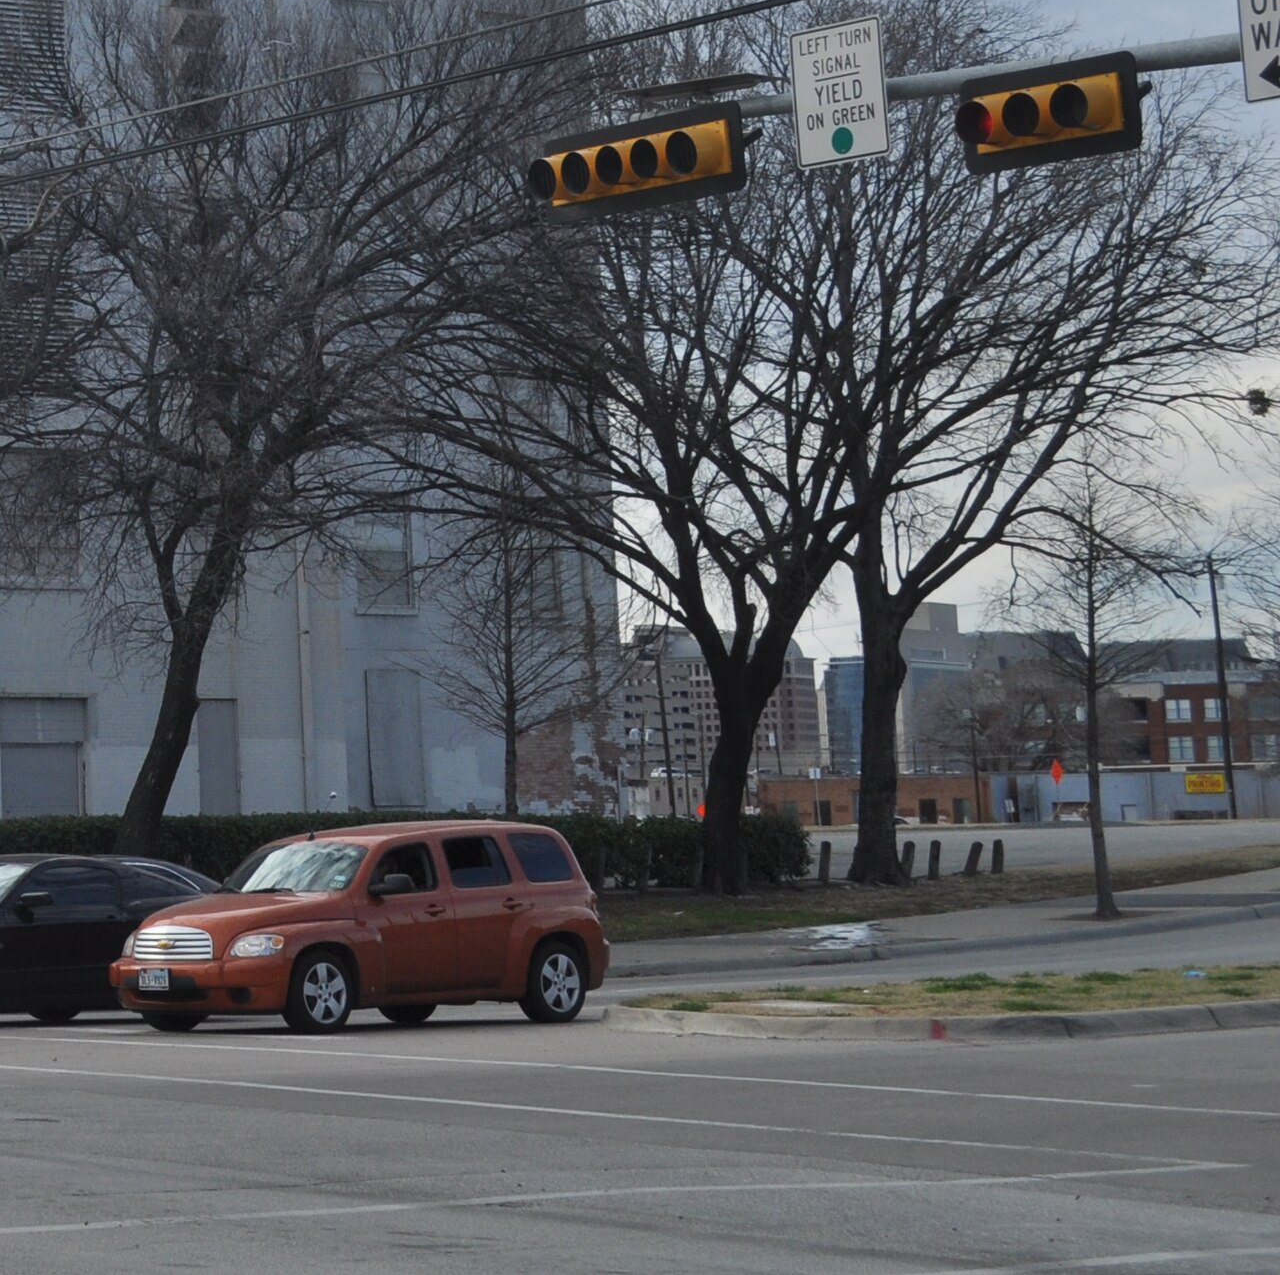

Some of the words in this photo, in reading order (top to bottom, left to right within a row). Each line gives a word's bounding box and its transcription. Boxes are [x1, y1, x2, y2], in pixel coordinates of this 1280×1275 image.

[799, 35, 828, 56] LEFT
[838, 26, 871, 47] TURN
[813, 52, 861, 76] SIGNAL
[815, 79, 863, 106] YIELD
[807, 113, 824, 131] ON
[832, 103, 875, 126] GREEN
